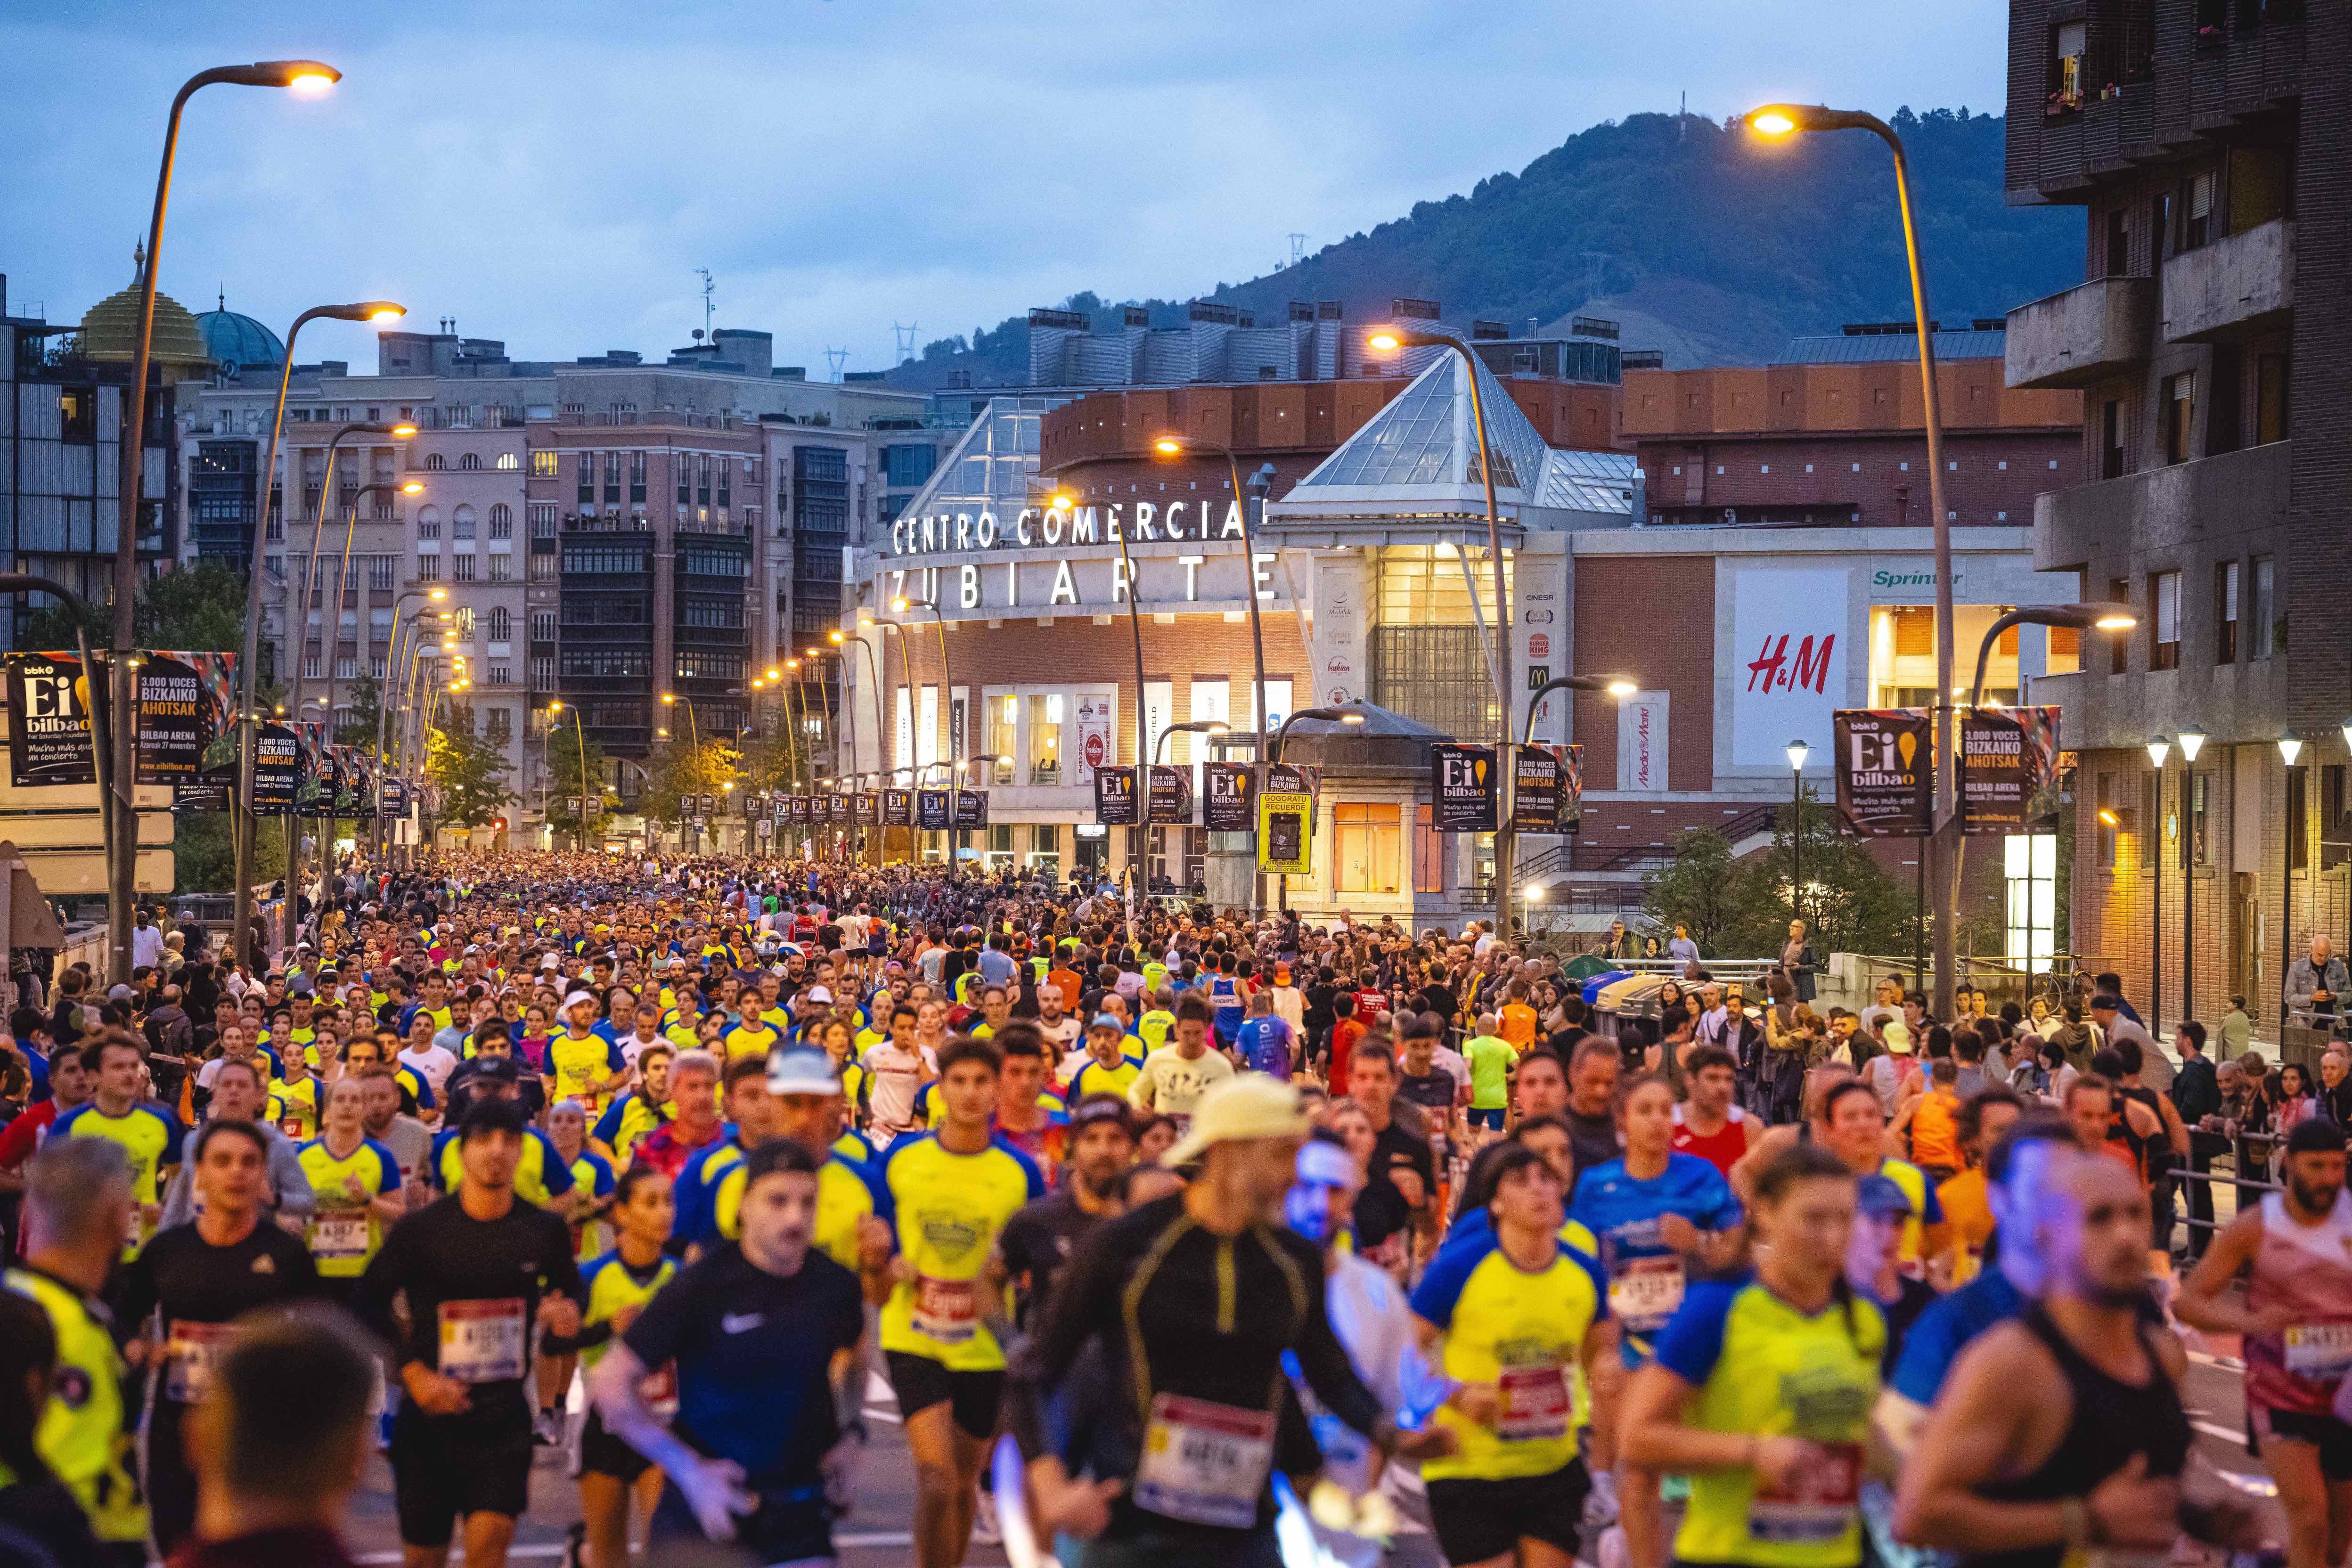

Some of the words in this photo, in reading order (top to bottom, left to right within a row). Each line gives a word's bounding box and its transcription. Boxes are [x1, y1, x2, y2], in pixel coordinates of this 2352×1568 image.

[893, 512, 996, 554] CENTRO
[1328, 662, 1350, 671] baskian
[1748, 634, 1835, 694] H&M
[24, 667, 45, 675] bbk
[142, 677, 165, 687] 3.000
[169, 678, 196, 687] VOCES
[142, 687, 197, 702] BIZKAIKO
[141, 701, 196, 716] AHOTSAK
[27, 717, 91, 732] bilbao
[140, 731, 169, 740] BILBAO
[171, 731, 196, 741] ARENA
[1993, 731, 2020, 741] VOCES
[28, 744, 55, 752] Mucho
[57, 743, 75, 752] más
[169, 742, 196, 750] noviembre
[258, 745, 296, 756] BIZKAIKO
[1966, 741, 2021, 754] BIZKAIKO
[41, 752, 79, 761] concierto
[257, 755, 294, 765] AHOTSAK
[1965, 755, 2020, 768] AHOTSAK
[1518, 768, 1555, 777] BIZKAIKO
[1518, 777, 1555, 787] AHOTSAK
[1852, 773, 1915, 786] bilbao
[1271, 781, 1300, 790] BIZKAIKO
[1444, 787, 1486, 797] bilbao
